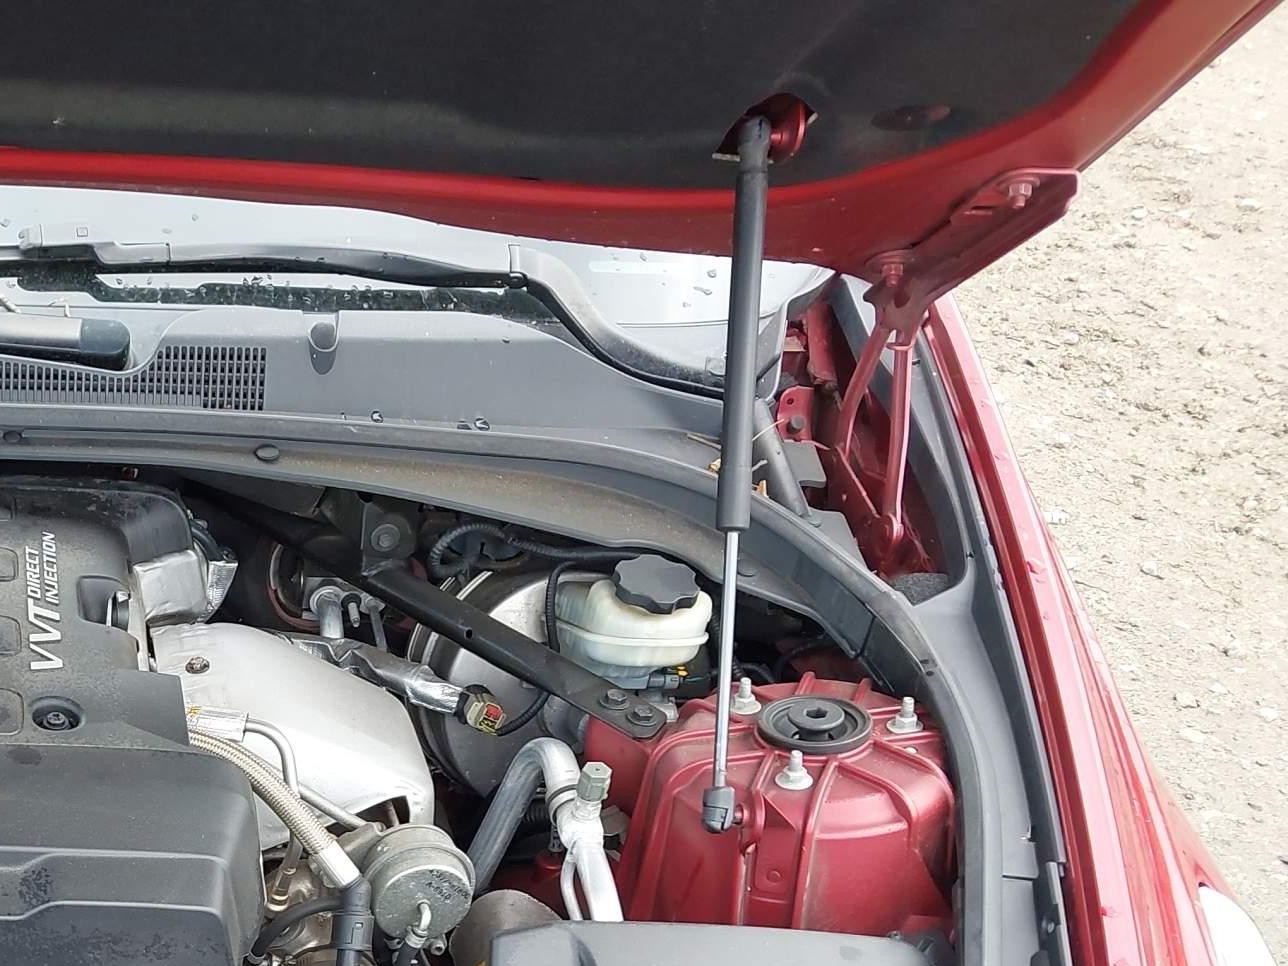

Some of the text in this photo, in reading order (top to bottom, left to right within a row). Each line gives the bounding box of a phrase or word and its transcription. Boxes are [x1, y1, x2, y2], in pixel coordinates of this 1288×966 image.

[25, 545, 42, 599] DIRECT
[41, 531, 60, 605] INJECTION
[27, 598, 64, 670] VVT
